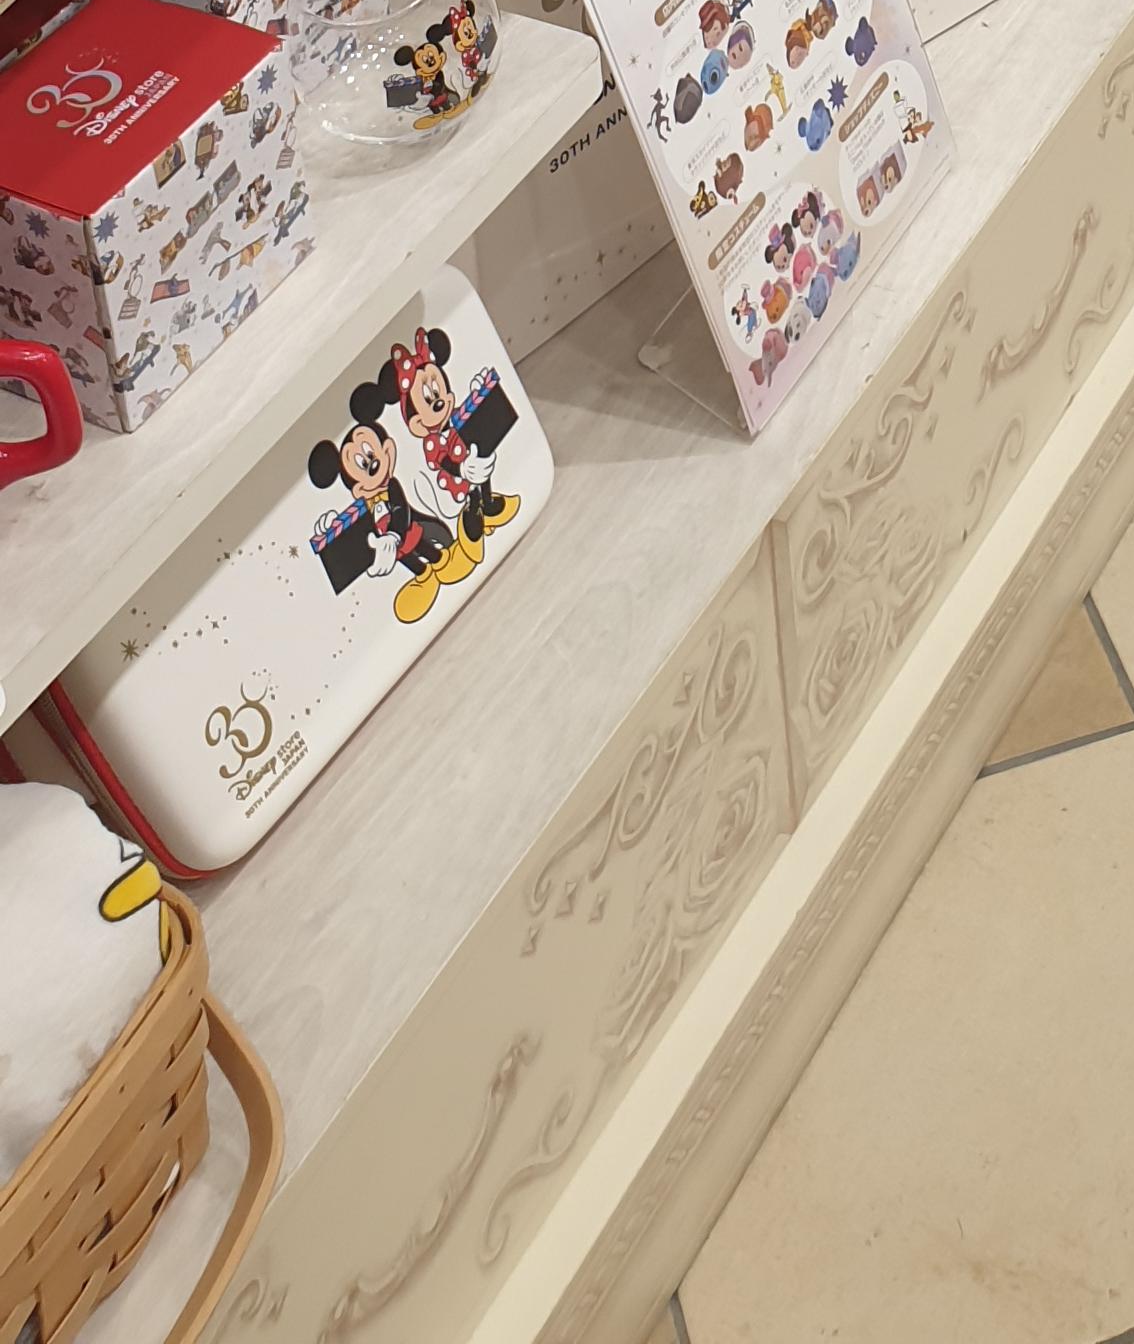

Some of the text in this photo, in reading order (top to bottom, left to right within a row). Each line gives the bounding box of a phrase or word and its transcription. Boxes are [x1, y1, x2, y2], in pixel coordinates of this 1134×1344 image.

[73, 70, 164, 137] Disney store
[103, 76, 181, 145] 30TH ANNIVERSARY
[549, 133, 591, 174] 30TH
[205, 701, 273, 779] 30
[228, 730, 301, 801] Disney store
[264, 747, 310, 799] ANNIVERSARY
[281, 739, 306, 767] JAPAN
